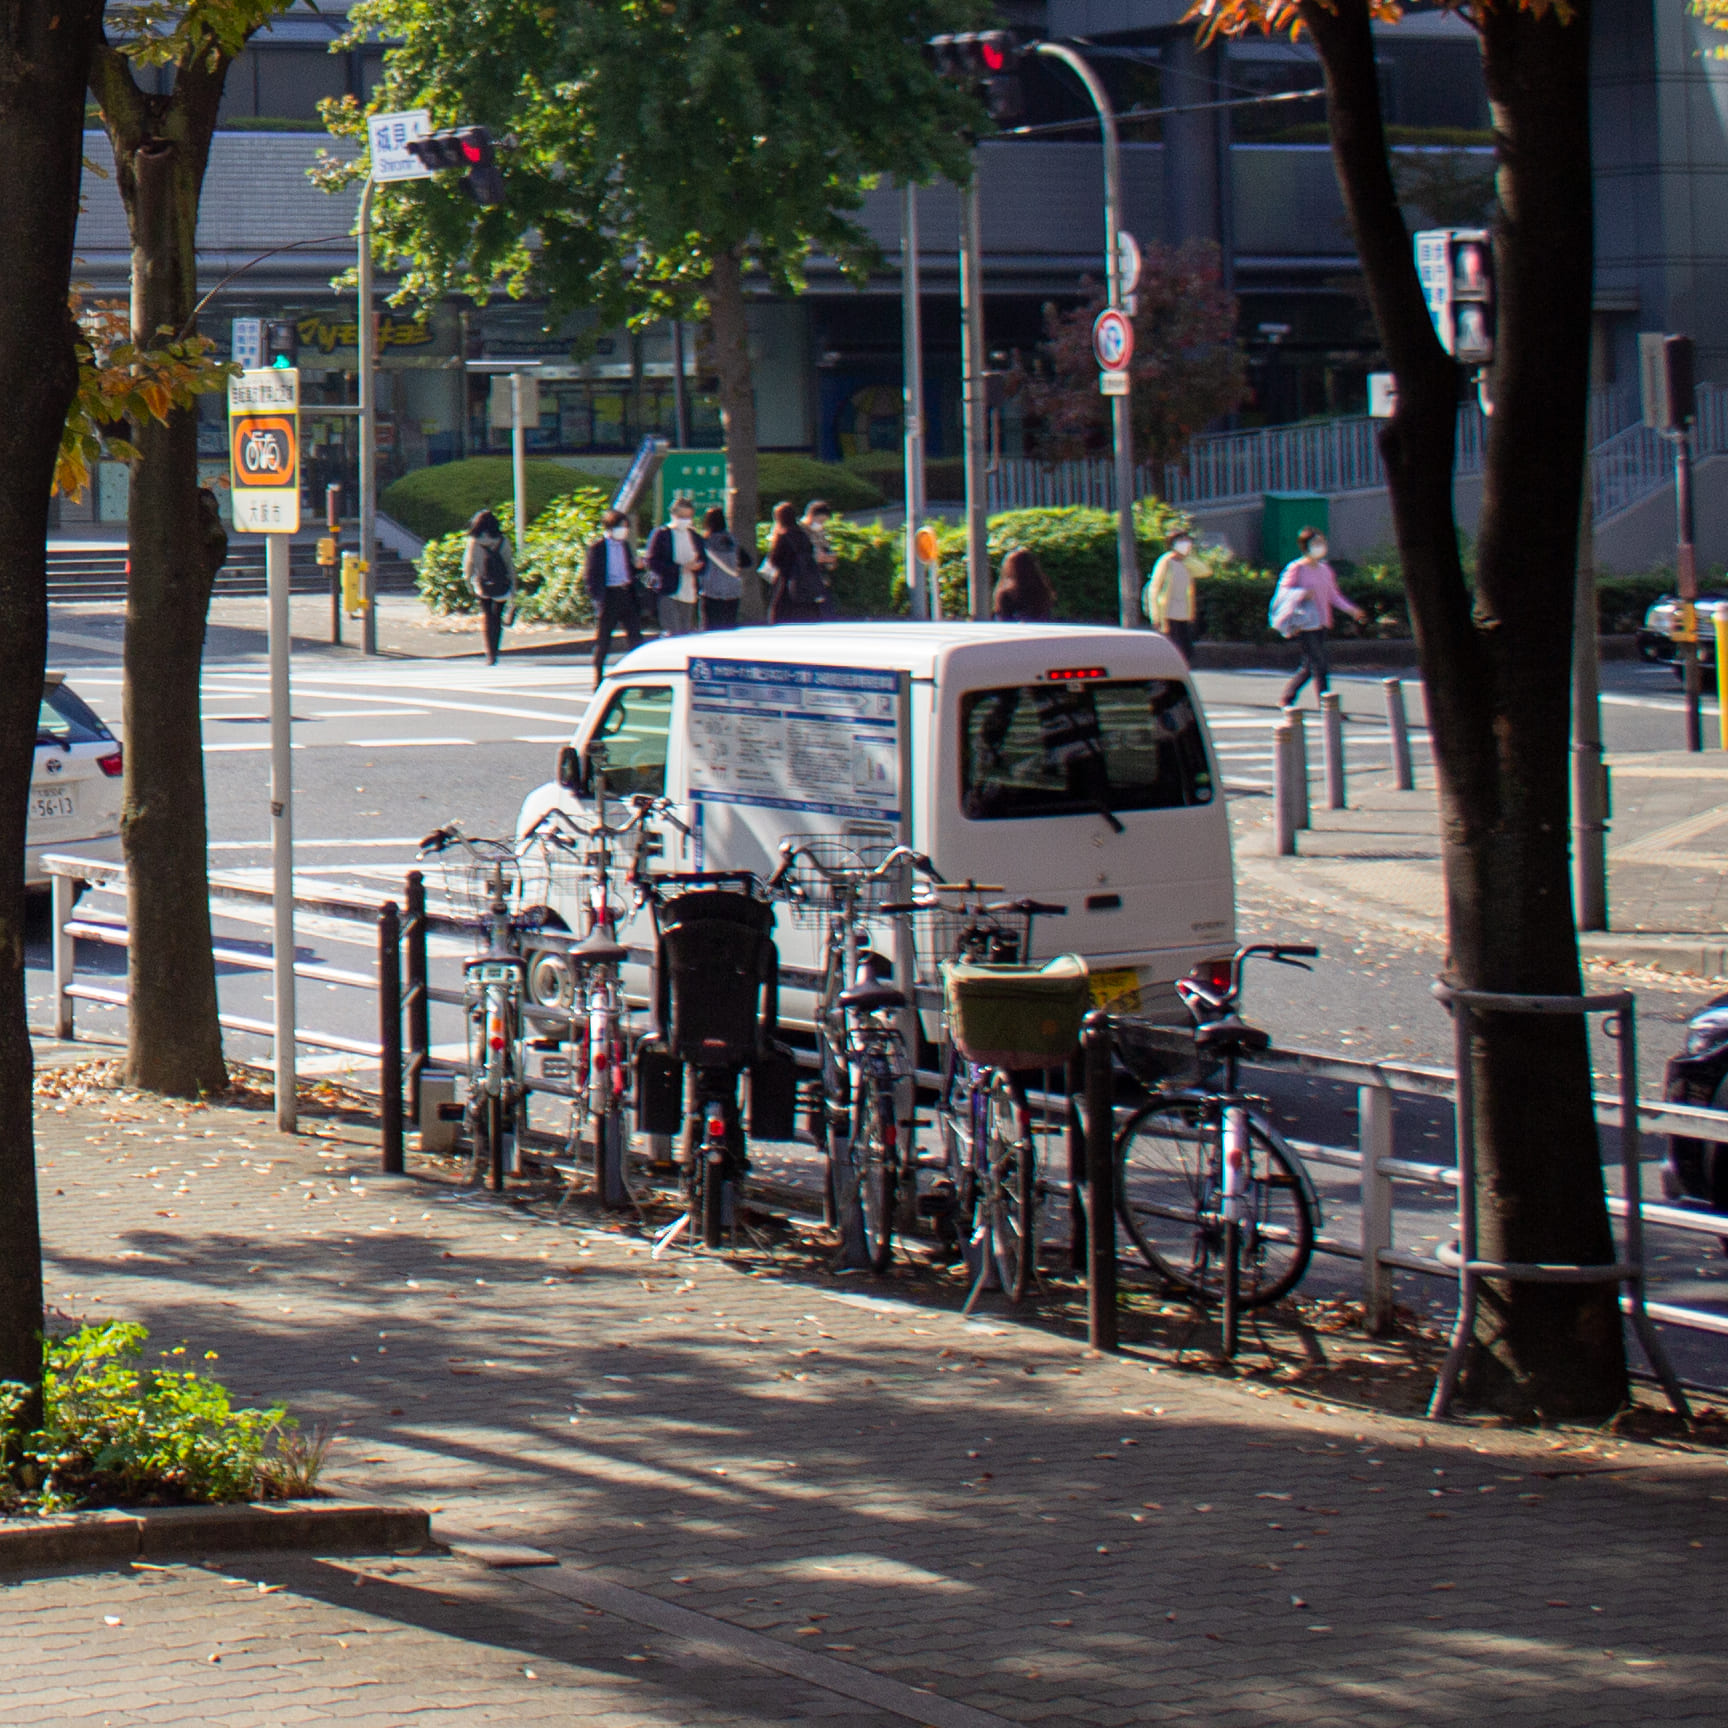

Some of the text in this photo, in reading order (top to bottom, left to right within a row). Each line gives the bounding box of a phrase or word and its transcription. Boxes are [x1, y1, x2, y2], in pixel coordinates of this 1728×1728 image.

[296, 318, 433, 353] マツモキヨシ
